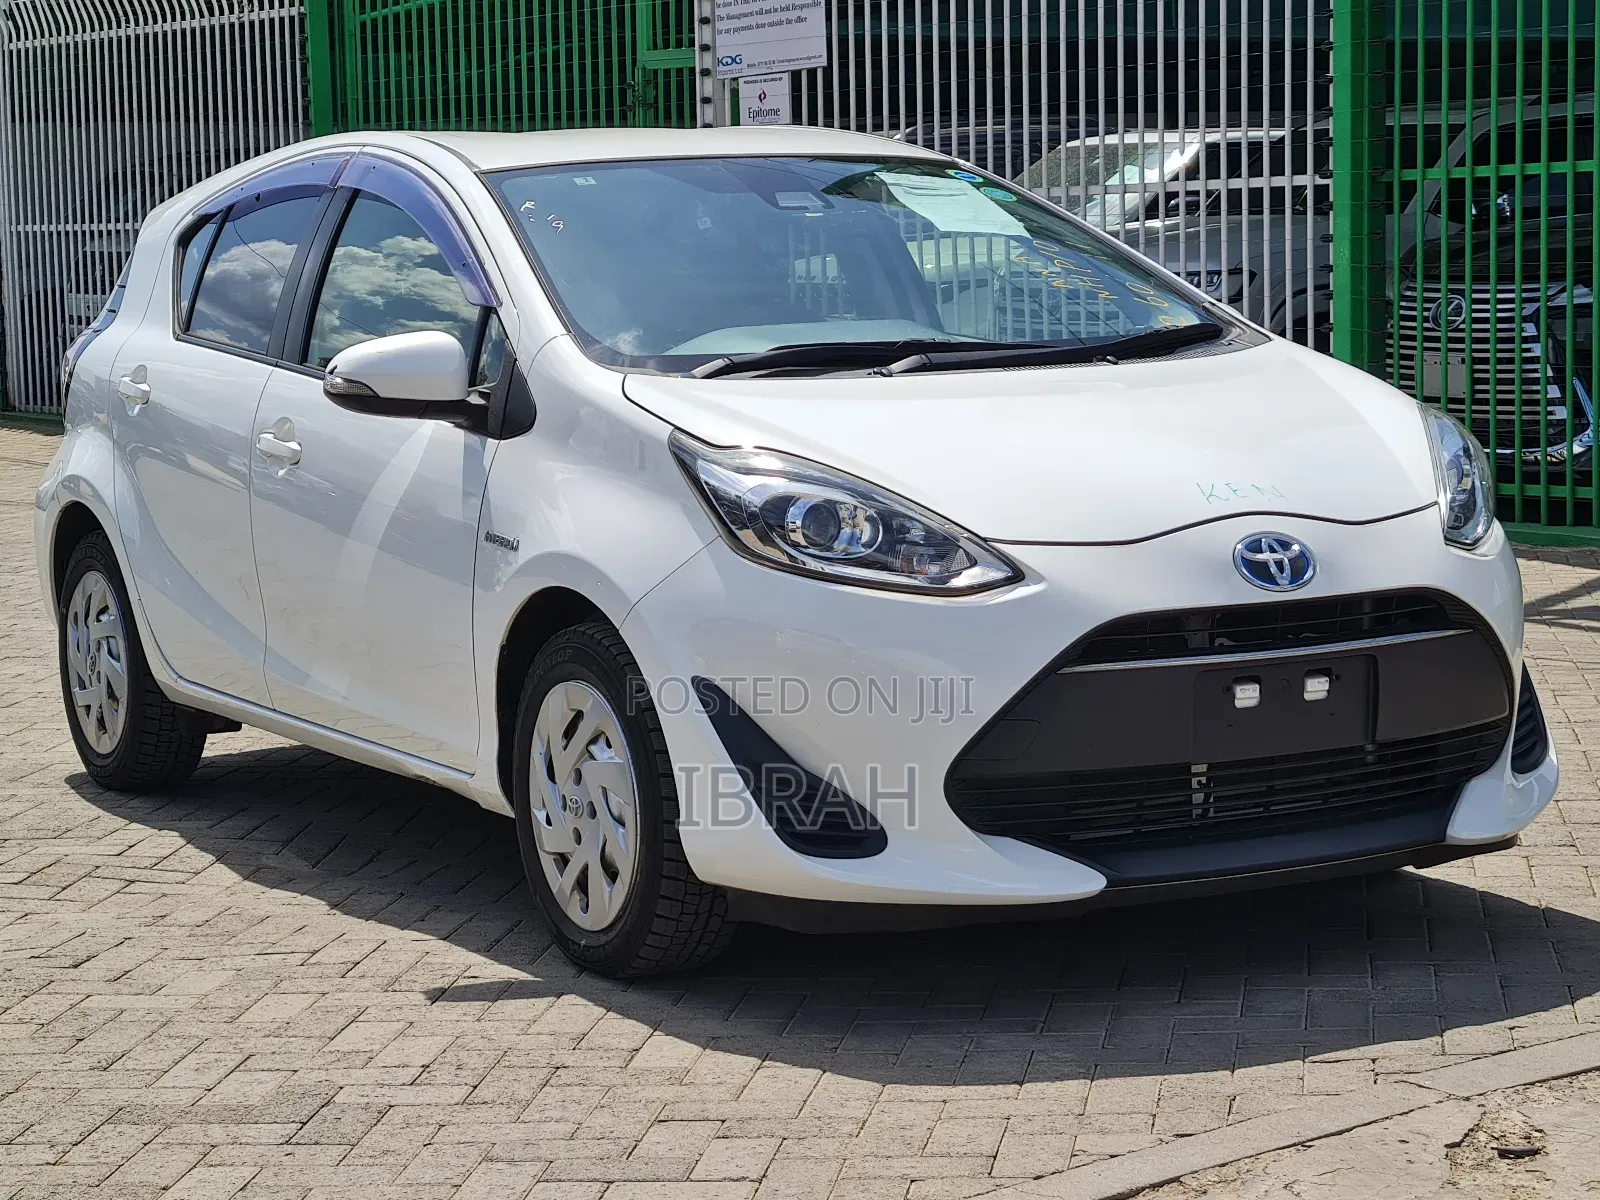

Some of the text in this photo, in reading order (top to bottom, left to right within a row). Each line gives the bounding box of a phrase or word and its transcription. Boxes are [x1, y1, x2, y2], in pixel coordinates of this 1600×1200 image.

[716, 14, 725, 22] The
[726, 10, 754, 21] Management
[755, 7, 763, 16] will
[773, 5, 779, 13] be
[780, 3, 791, 12] held
[791, 0, 822, 12] Responsible
[724, 28, 732, 36] any
[733, 24, 754, 35] payments
[755, 21, 766, 30] done
[767, 17, 784, 28] outside
[785, 17, 793, 25] the
[794, 15, 808, 24] office
[717, 53, 743, 67] KDG
[748, 105, 781, 122] Epitome
[1196, 482, 1291, 505] KEN
